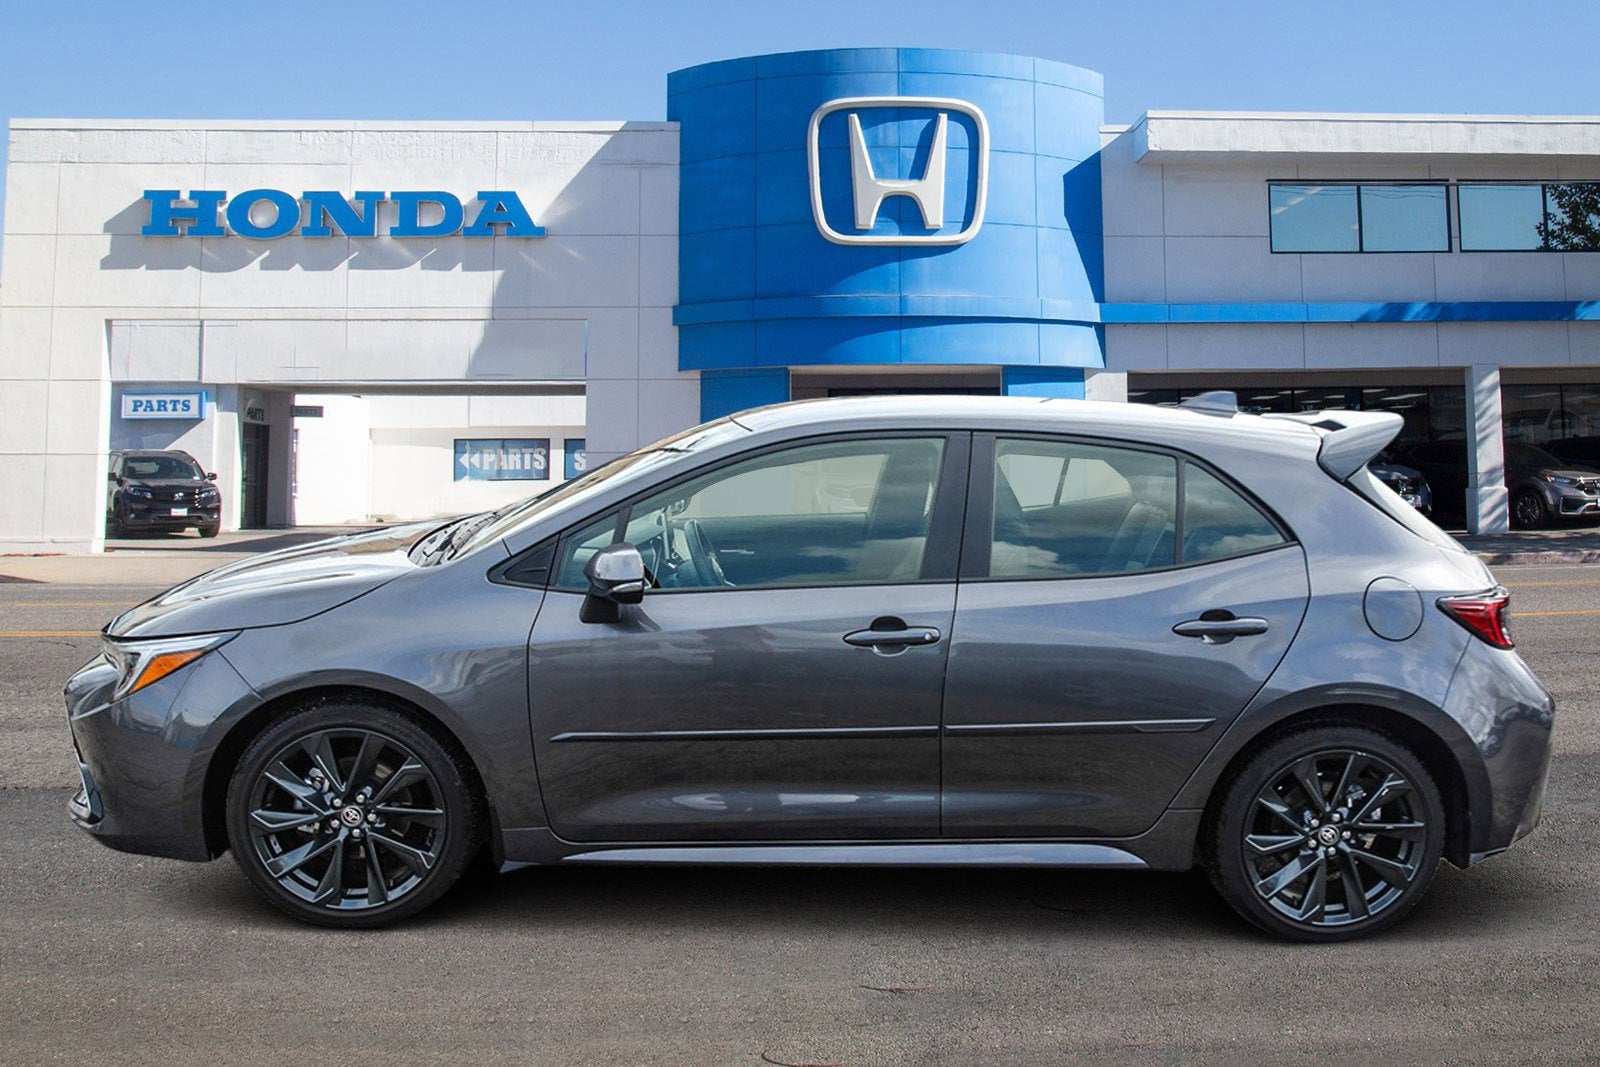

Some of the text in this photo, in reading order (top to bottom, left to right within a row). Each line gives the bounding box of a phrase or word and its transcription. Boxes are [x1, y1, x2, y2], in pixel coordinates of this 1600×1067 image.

[141, 188, 546, 239] HONDA
[132, 399, 191, 412] PARTS
[483, 448, 547, 470] PARTS
